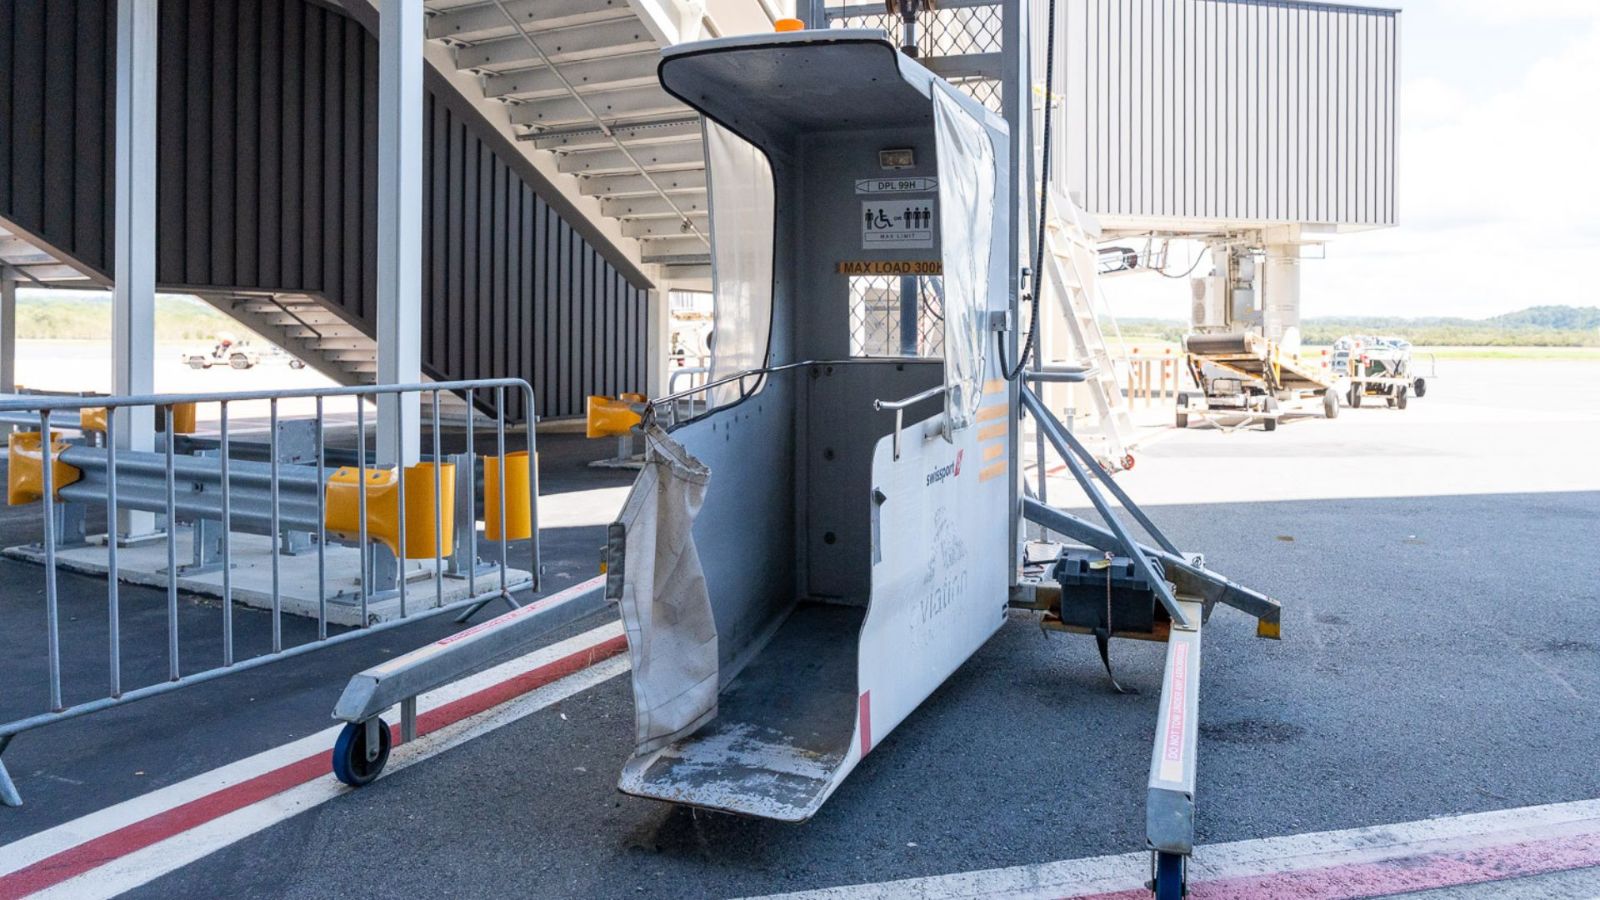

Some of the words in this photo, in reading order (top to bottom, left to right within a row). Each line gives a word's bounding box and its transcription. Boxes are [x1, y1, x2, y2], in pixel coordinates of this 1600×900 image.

[878, 181, 896, 190] DPL
[899, 180, 916, 189] 99H
[844, 262, 871, 273] MAX
[875, 262, 911, 273] LOAD
[926, 459, 955, 487] swissport
[1169, 731, 1180, 746] NOT
[1168, 747, 1178, 759] DO
